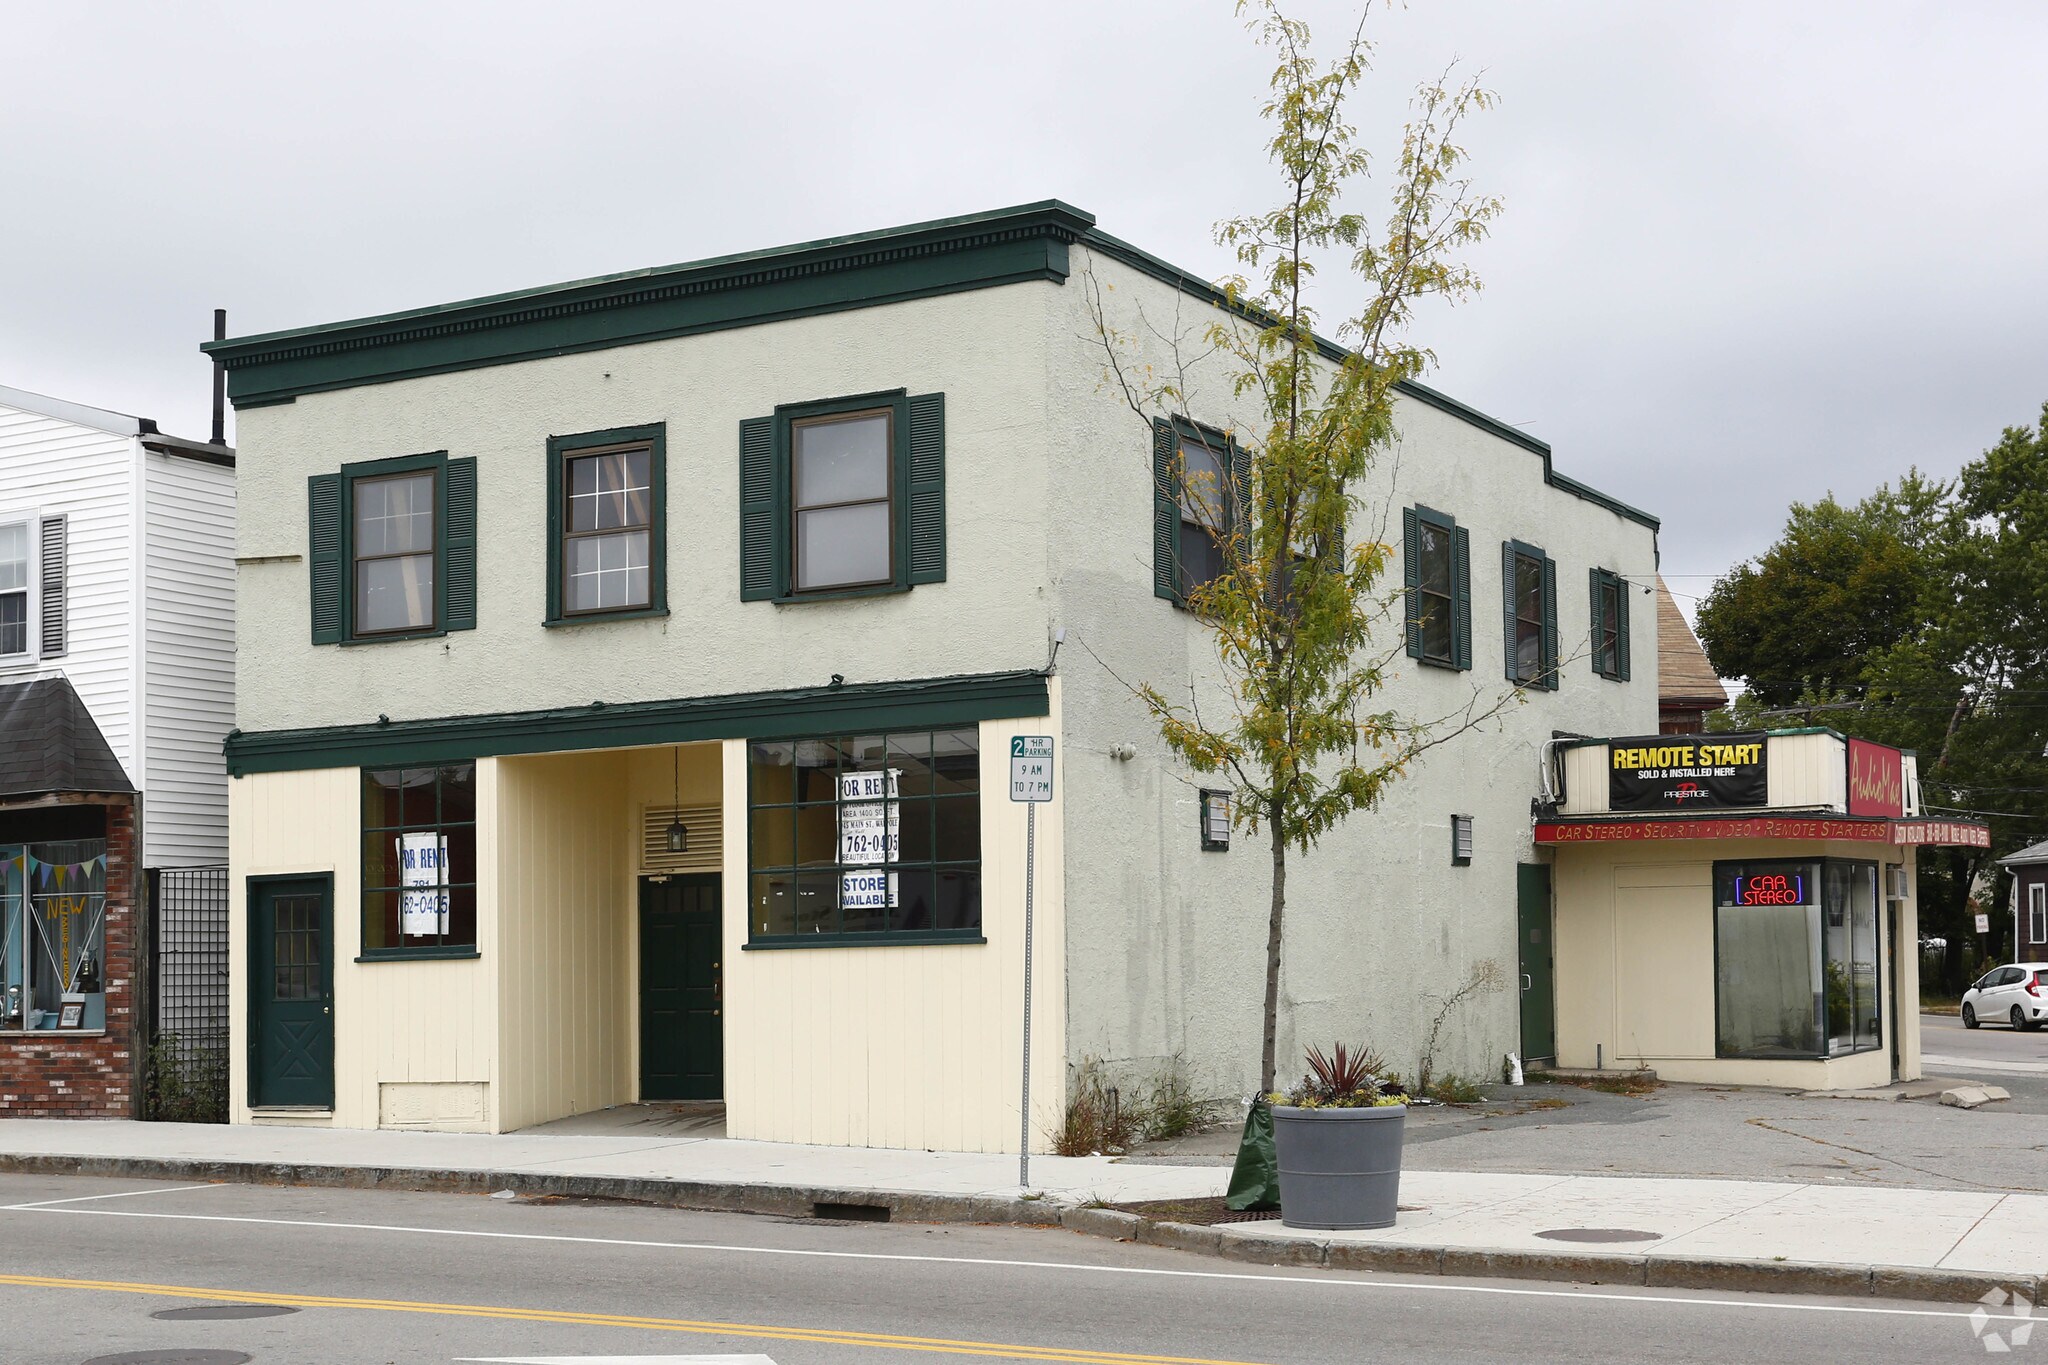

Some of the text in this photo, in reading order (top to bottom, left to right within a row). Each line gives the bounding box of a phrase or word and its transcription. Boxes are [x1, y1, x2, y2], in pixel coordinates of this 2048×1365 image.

[1013, 739, 1044, 756] 2 HR
[1025, 748, 1052, 756] PARKING
[1614, 744, 1762, 769] REMOTE START
[1022, 765, 1042, 775] 9 AM
[1638, 767, 1736, 780] SOLD & INSTALLED HERE
[842, 779, 860, 797] OR
[1015, 782, 1049, 793] TO 7 PM
[1664, 789, 1709, 799] PRESTIGE
[859, 809, 873, 817] 1400
[876, 819, 898, 828] WAOLE
[1556, 825, 1581, 840] CAR
[1585, 825, 1632, 839] STEREO
[1715, 823, 1751, 837] VDEO
[1764, 821, 1816, 836] REMOTE
[1820, 822, 1886, 837] STARTERS
[847, 834, 898, 852] 762-0405
[402, 849, 415, 869] OR
[871, 852, 895, 860] LOCAON
[844, 877, 886, 892] STORE
[1750, 875, 1787, 891] CAR
[403, 896, 448, 914] 62-0405
[1744, 889, 1797, 905] STEREO
[47, 896, 87, 920] NEW
